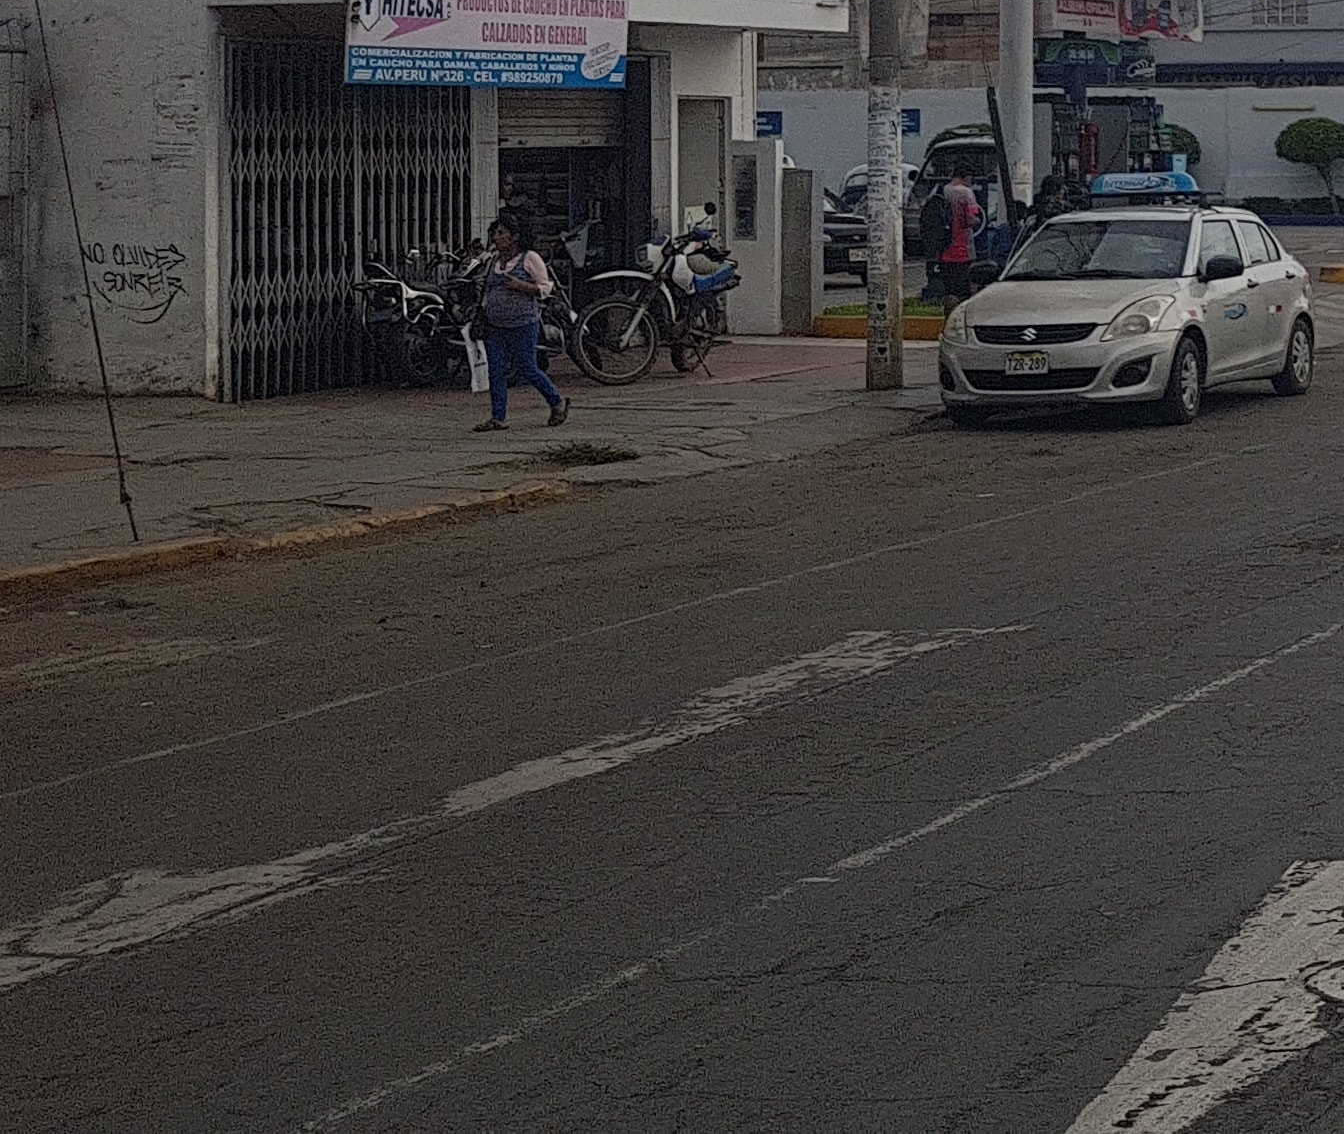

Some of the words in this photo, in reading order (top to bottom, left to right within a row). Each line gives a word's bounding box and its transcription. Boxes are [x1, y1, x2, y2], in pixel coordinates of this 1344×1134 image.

[606, 0, 626, 20] PARA
[482, 22, 532, 44] CALZADOS
[534, 24, 546, 44] EN
[548, 26, 587, 46] GENERAL
[351, 47, 452, 59] COMERCIALIZACION
[455, 51, 462, 59] Y
[464, 51, 524, 61] FABRICACION
[526, 53, 538, 62] DE
[540, 54, 578, 63] PLANTAS
[351, 57, 367, 66] EN
[369, 58, 413, 68] CAUCHO
[415, 60, 442, 69] PARA
[481, 62, 538, 71] CABALLEROS
[541, 63, 547, 71] Y
[80, 243, 105, 264] NO
